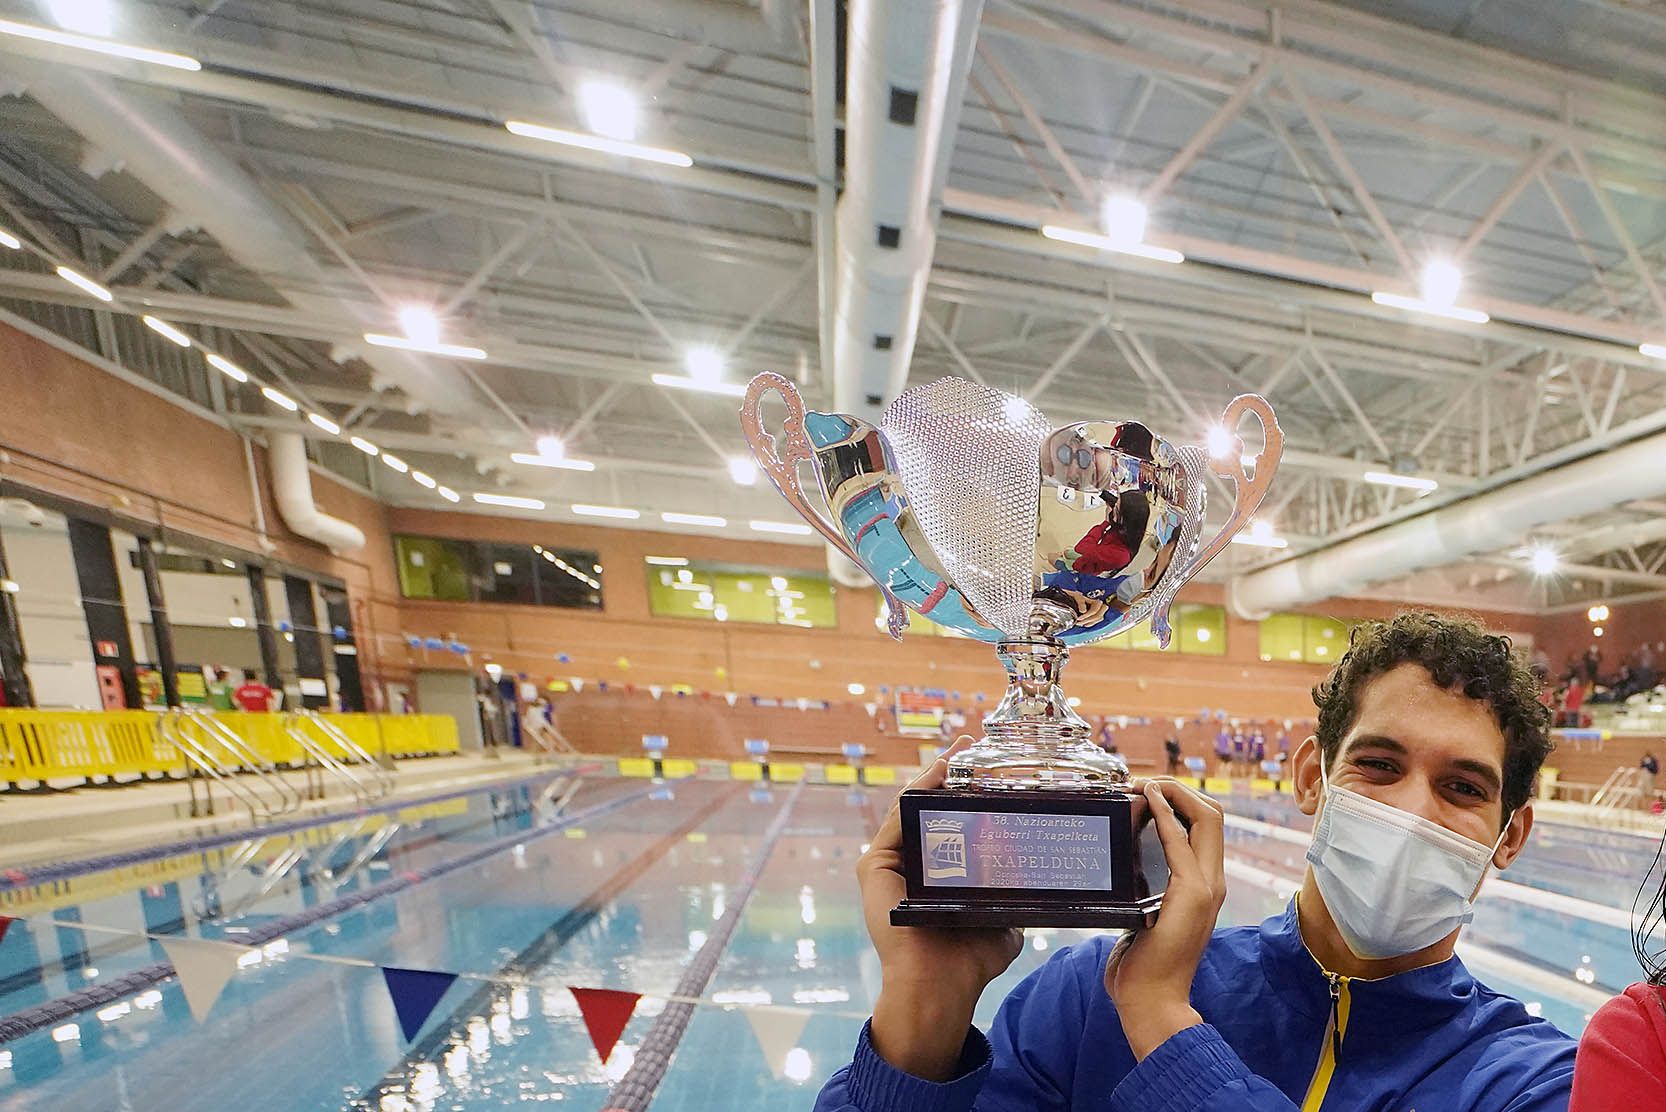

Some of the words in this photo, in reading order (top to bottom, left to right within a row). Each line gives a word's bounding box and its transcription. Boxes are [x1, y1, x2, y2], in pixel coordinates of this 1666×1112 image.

[992, 815, 1009, 826] 38.
[1015, 815, 1086, 828] Nazioarteko
[979, 828, 1031, 841] Eguberri
[1036, 829, 1099, 842] Txapelketa
[1004, 843, 1033, 853] CIUDAD
[1037, 844, 1047, 853] DE
[1050, 844, 1066, 854] SAN
[979, 855, 1101, 870] TXAPELDUNA
